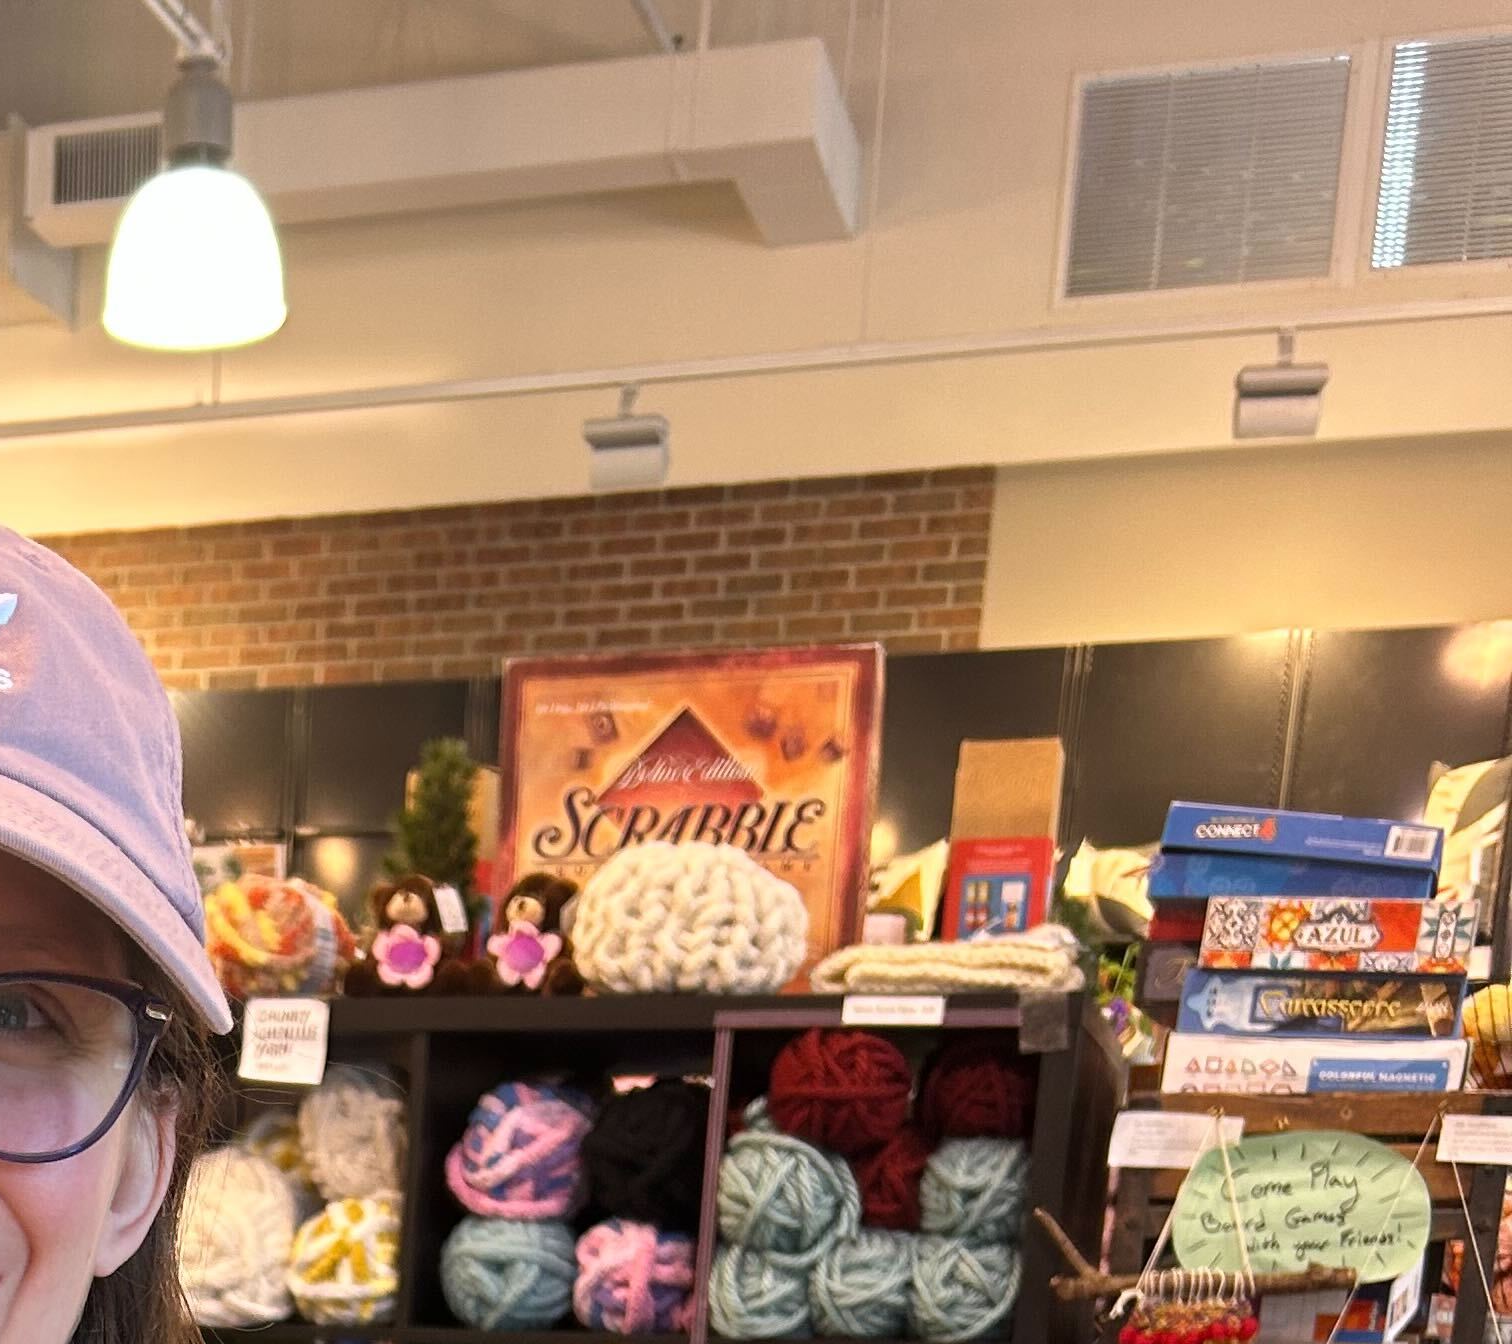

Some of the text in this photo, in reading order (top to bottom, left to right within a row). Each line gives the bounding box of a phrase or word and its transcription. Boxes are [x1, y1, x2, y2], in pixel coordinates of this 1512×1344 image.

[532, 787, 826, 858] SCRABBLE
[1196, 823, 1259, 840] CONNECT
[1305, 925, 1366, 945] AZUL
[1378, 1071, 1436, 1083] MAGNETIC
[1221, 1159, 1359, 1211] Come Play
[1200, 1209, 1266, 1235] Board
